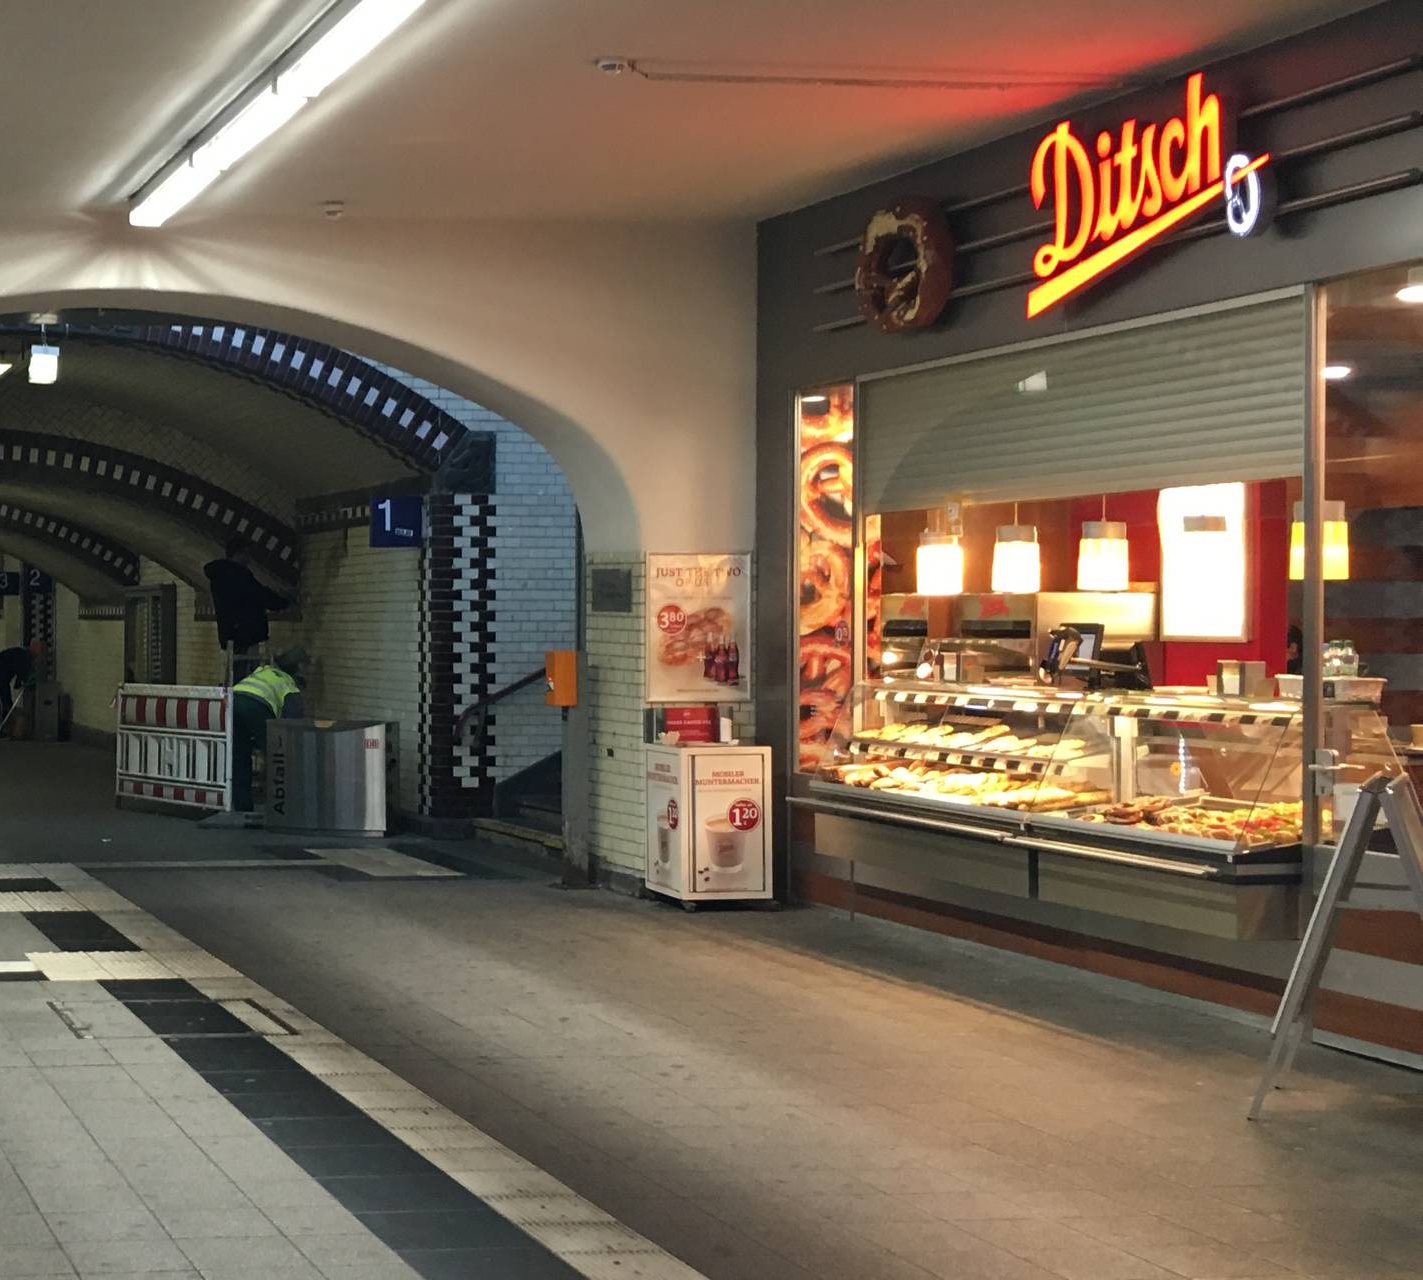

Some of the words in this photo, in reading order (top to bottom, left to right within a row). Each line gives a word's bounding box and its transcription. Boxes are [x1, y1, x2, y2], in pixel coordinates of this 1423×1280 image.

[1031, 72, 1221, 277] Ditsch
[378, 499, 391, 531] 1
[0, 573, 8, 589] 3
[29, 568, 41, 586] 2
[656, 567, 683, 579] JUST
